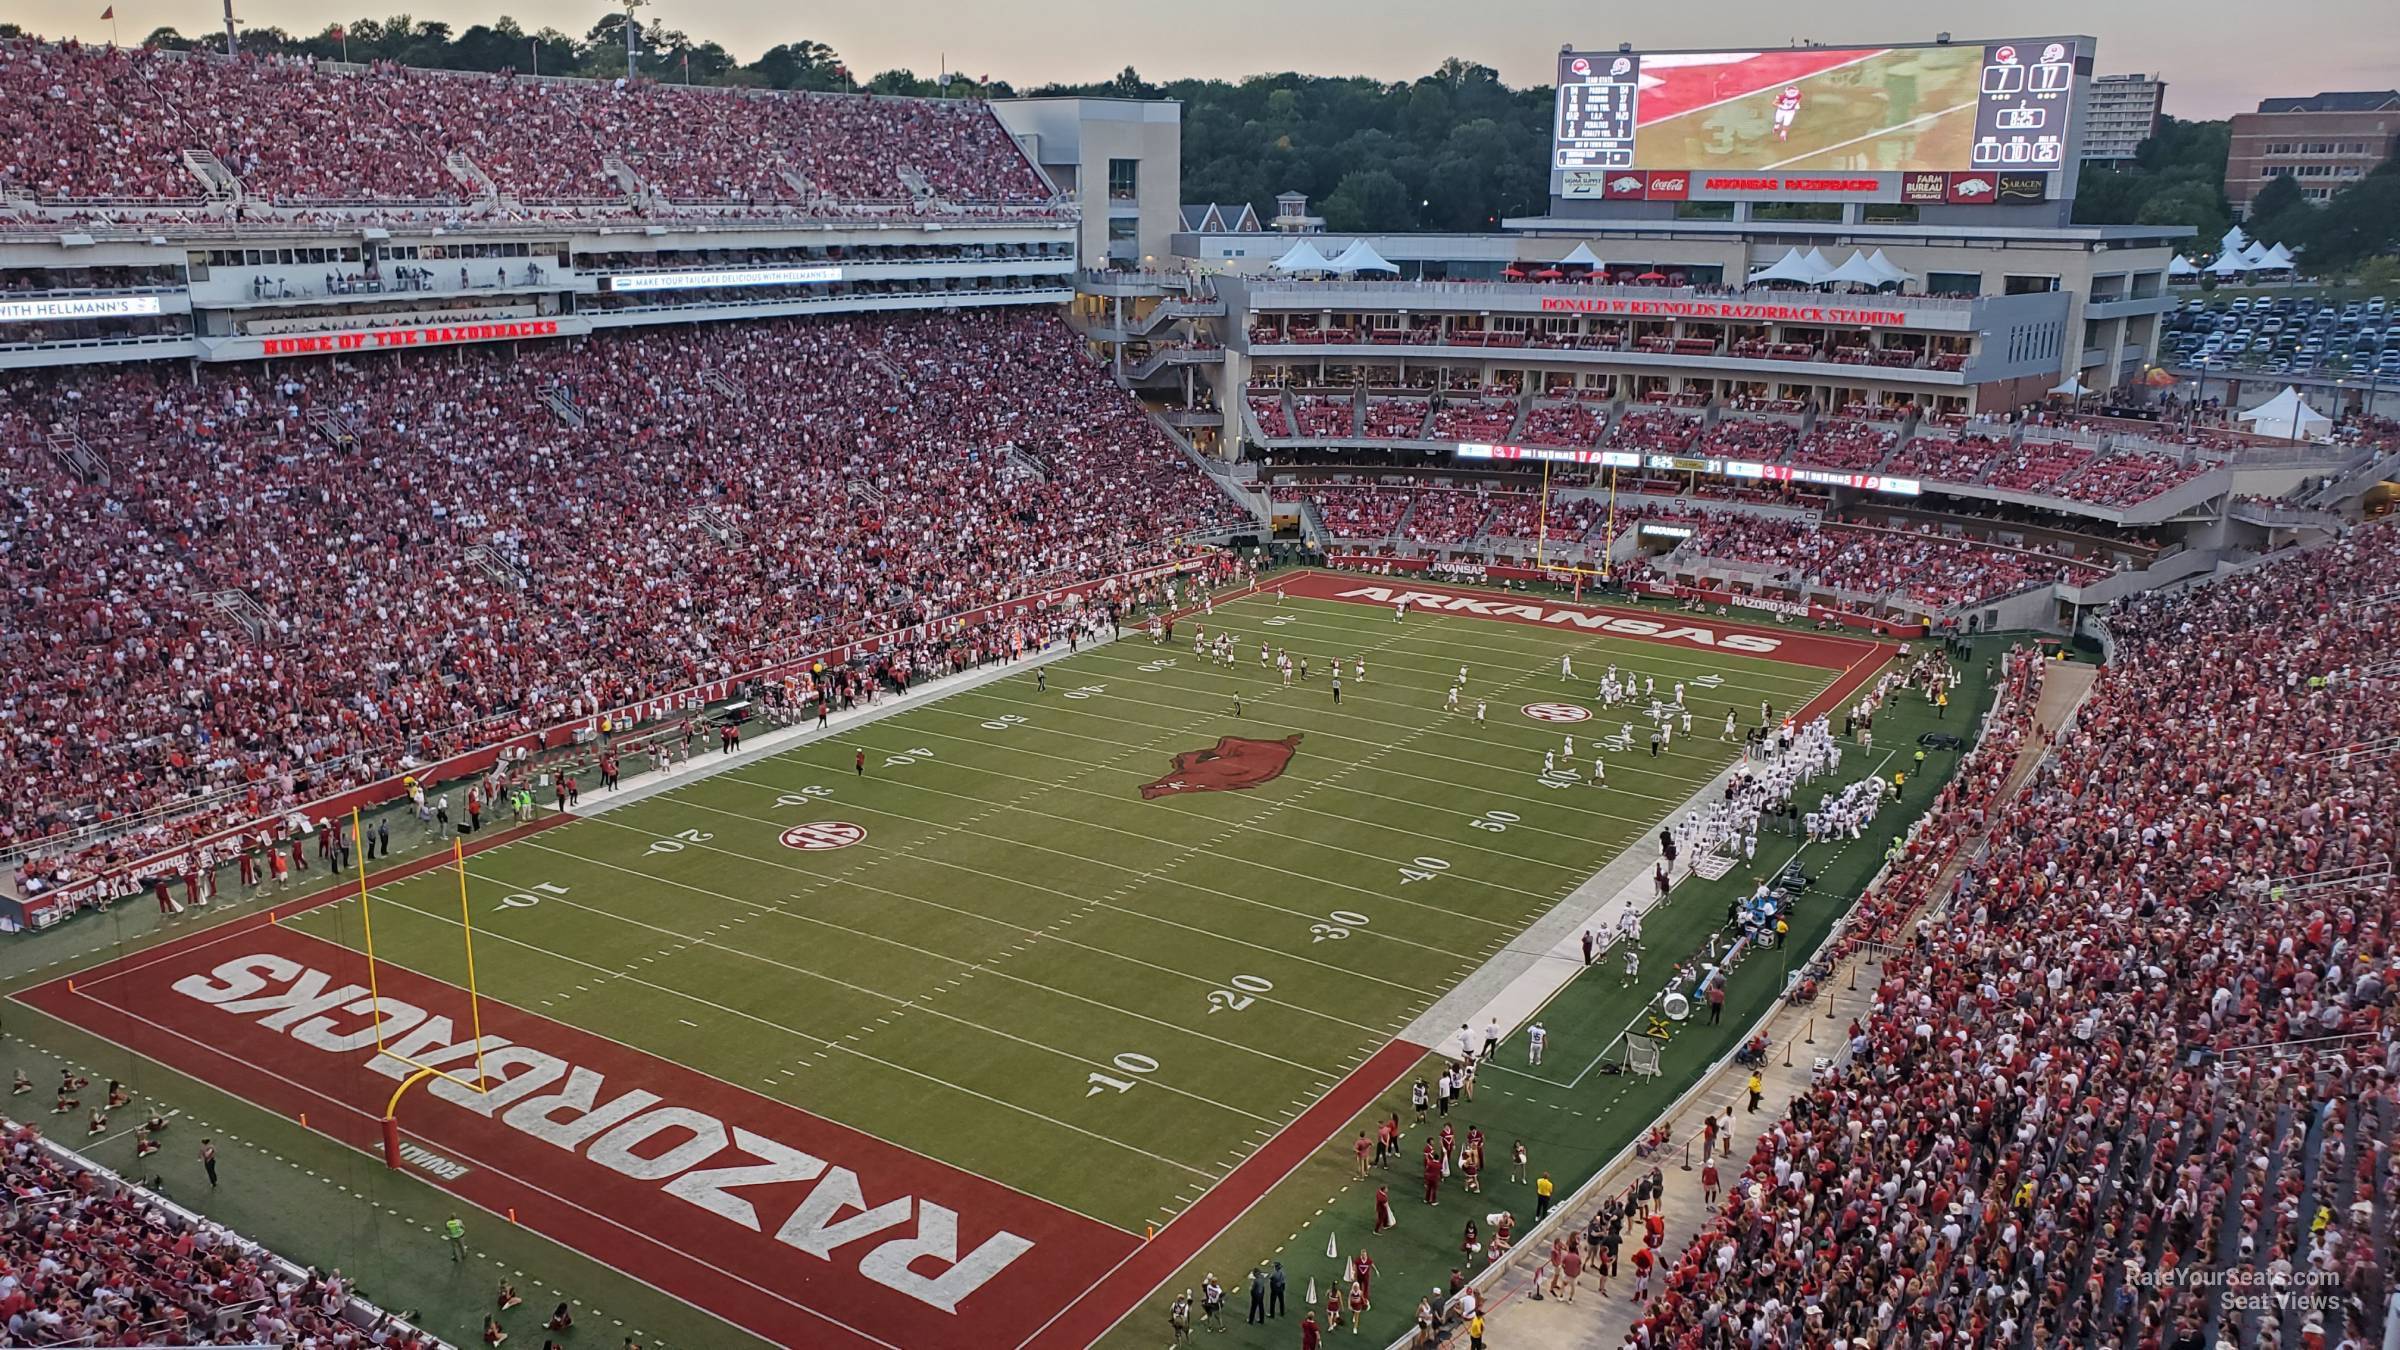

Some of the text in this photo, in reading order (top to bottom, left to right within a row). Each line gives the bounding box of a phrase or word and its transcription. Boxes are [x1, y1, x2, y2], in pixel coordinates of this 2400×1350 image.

[1998, 68, 2009, 90] 7
[2042, 66, 2058, 89] 17
[2010, 111, 2034, 126] 8:25
[2012, 144, 2023, 160] 10
[2039, 144, 2053, 160] 25
[1906, 183, 1943, 192] BUREAU
[1917, 175, 1942, 183] FARM
[2000, 177, 2042, 190] SARACEN
[636, 277, 658, 287] MAKE
[660, 276, 683, 286] YOUR
[685, 274, 720, 285] TAILGATE
[721, 272, 762, 283] DELICIOUS
[763, 271, 782, 281] WITH
[37, 301, 129, 315] HELLMANN'S
[1541, 297, 1905, 325] DONALD W REYNOLDS RAZORBACK STADIUM
[263, 320, 557, 355] HOME OF THE RAZORBACKS
[1643, 525, 1691, 537] ARKANSAS
[1335, 586, 1782, 653] ARKANSAS
[1063, 684, 1108, 700] 40
[980, 714, 1029, 730] 50
[896, 747, 935, 766] 40
[1536, 769, 1582, 789] 40
[780, 785, 834, 806] 30
[1469, 810, 1521, 833] 50
[650, 829, 714, 853] 20
[1398, 856, 1450, 881] 40
[501, 881, 571, 909] 10
[1309, 910, 1370, 940] 30
[1207, 974, 1274, 1011] 20
[1087, 1052, 1160, 1095] 10
[171, 953, 1036, 1315] RAZORBACKS
